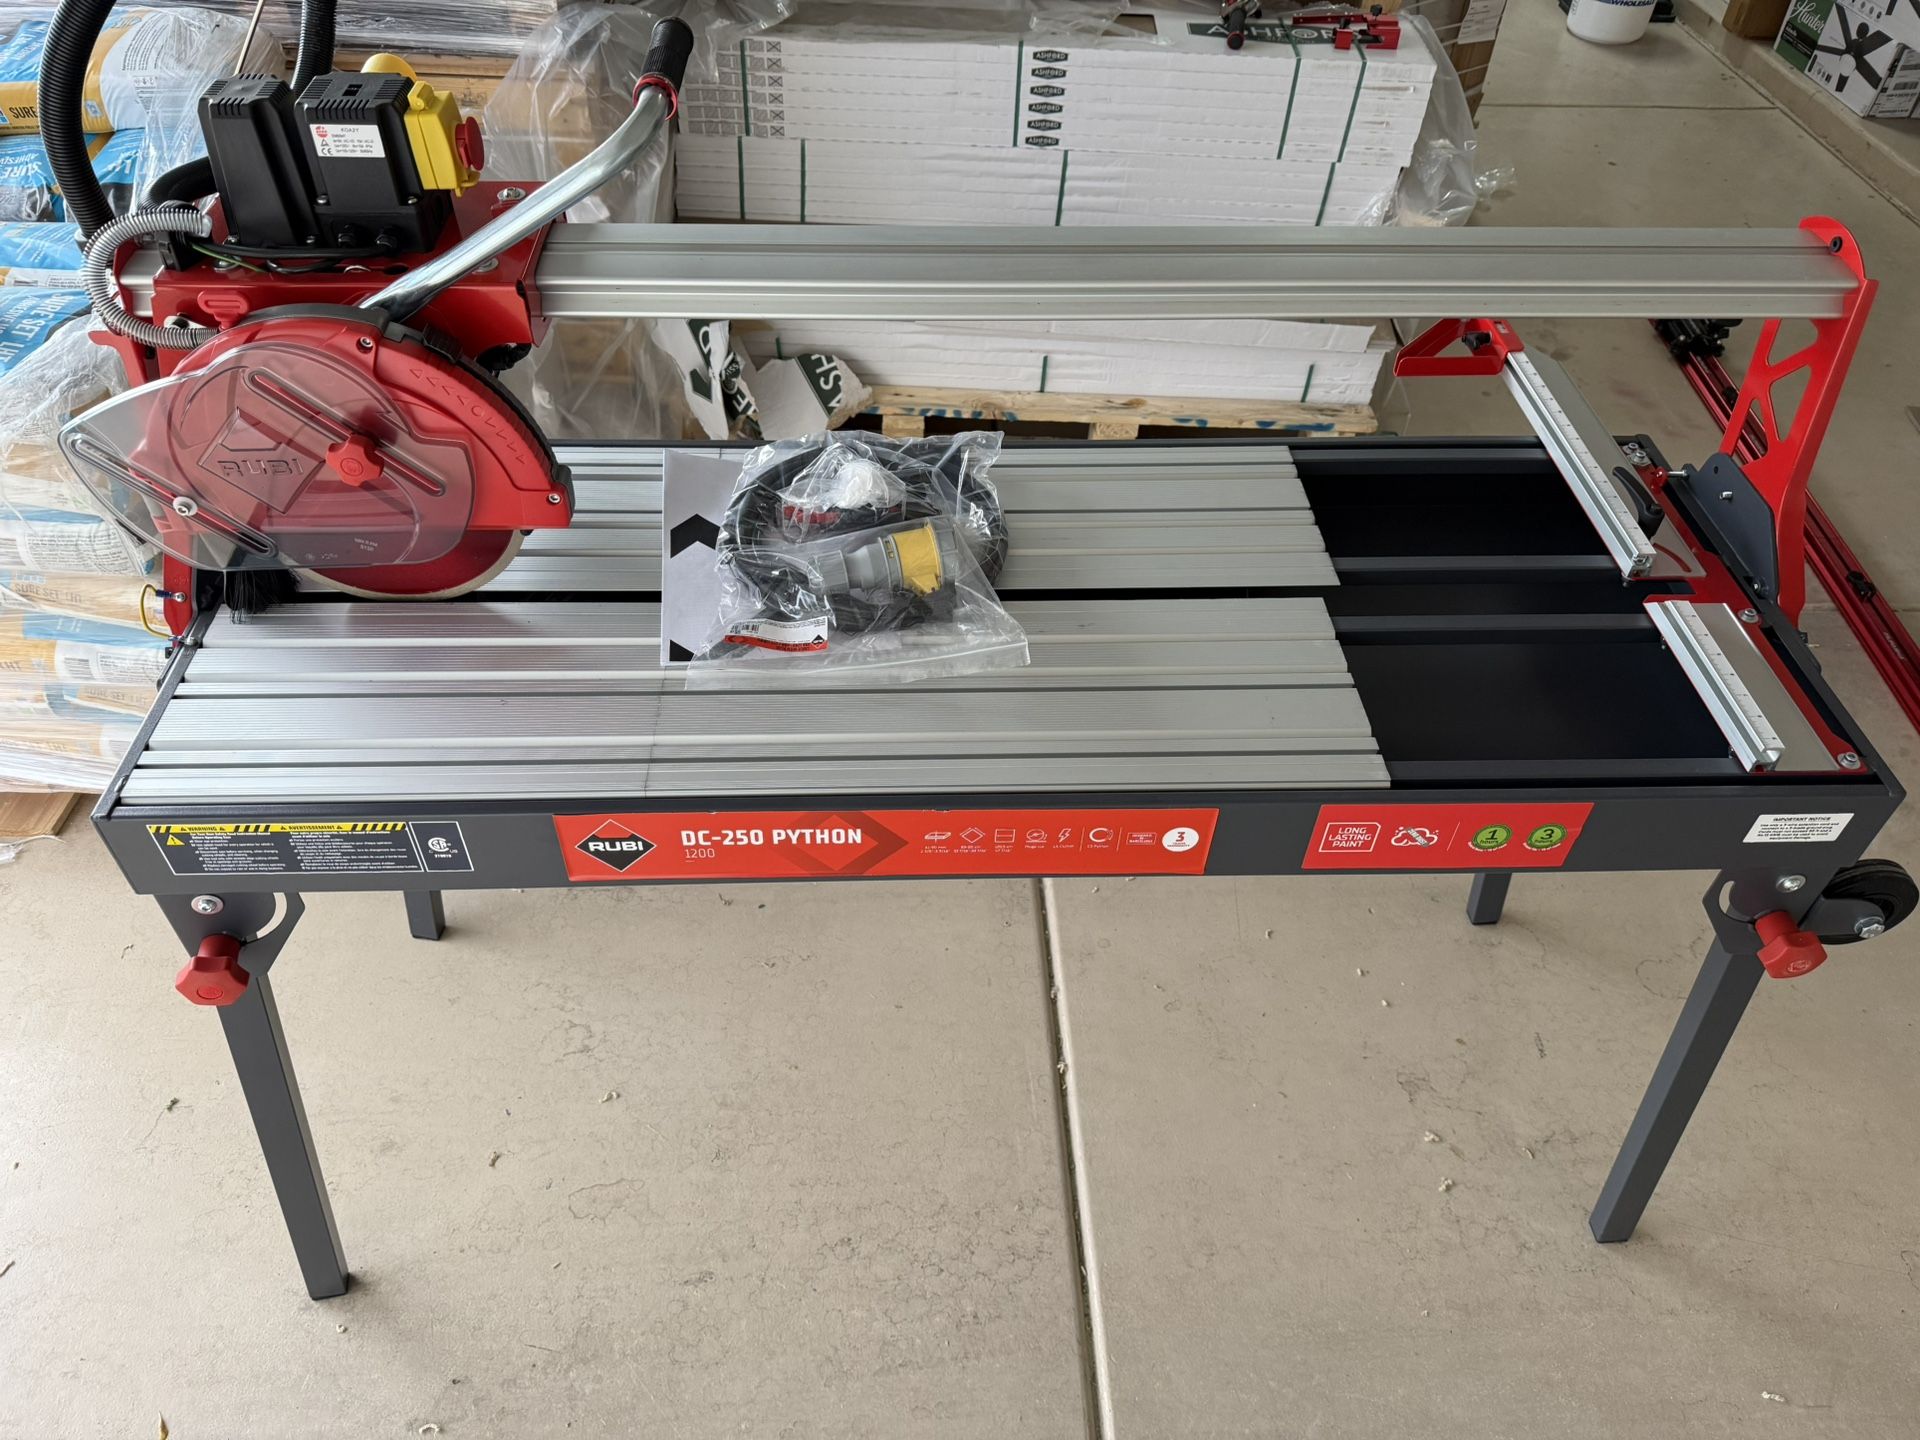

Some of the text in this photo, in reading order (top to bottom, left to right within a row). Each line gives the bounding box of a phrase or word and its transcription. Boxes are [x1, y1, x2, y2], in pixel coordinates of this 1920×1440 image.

[1790, 0, 1824, 33] Hunter
[9, 106, 38, 119] SURE
[217, 457, 304, 477] RUBI
[681, 828, 863, 846] DC-250 PYTHON
[1175, 832, 1186, 842] 3
[1485, 829, 1498, 840] 1
[1540, 828, 1555, 840] 3
[588, 841, 644, 852] RUBI
[684, 848, 715, 859] 1200
